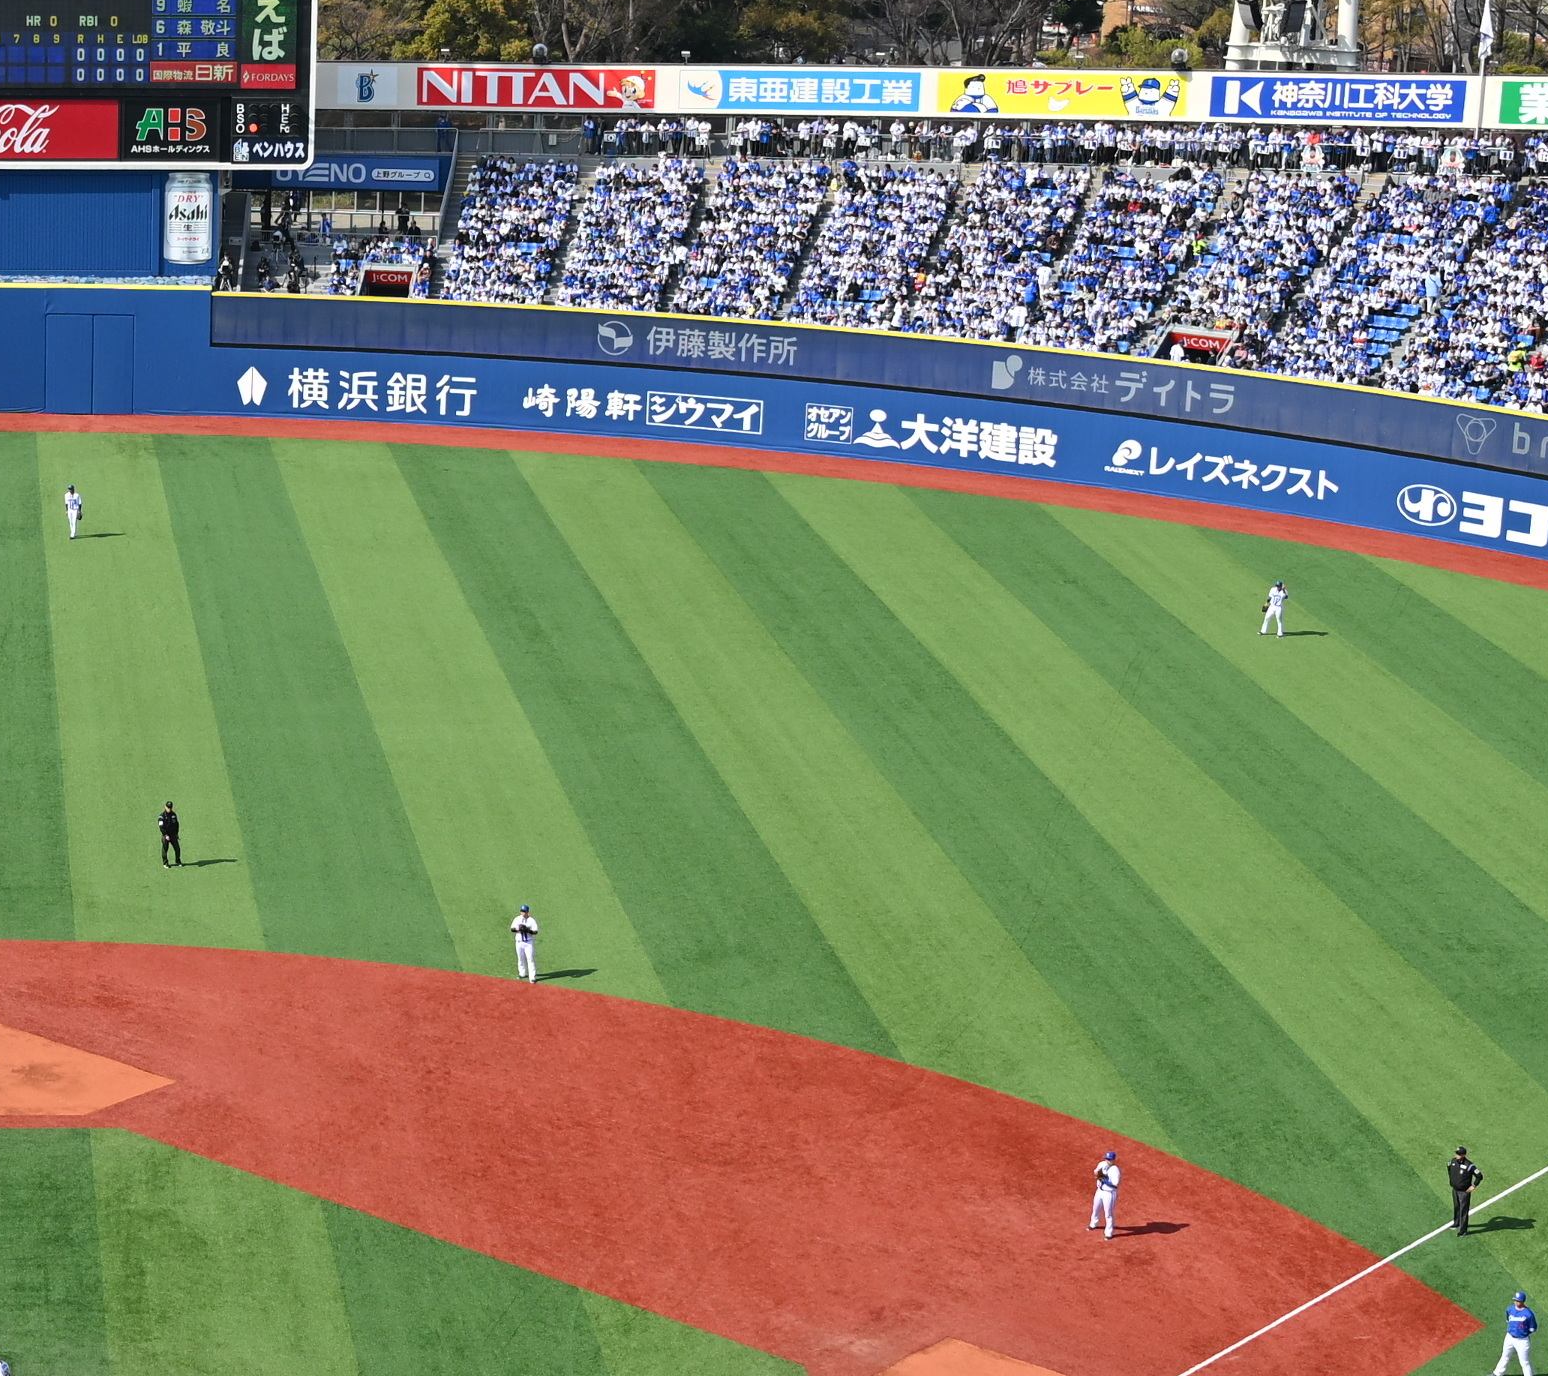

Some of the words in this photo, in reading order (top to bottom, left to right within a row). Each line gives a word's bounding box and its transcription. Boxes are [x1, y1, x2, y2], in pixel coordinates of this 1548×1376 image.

[251, 72, 294, 82] FORDAYS
[422, 69, 606, 106] NITTAN
[1006, 79, 1114, 97] 鳩サブレー
[728, 76, 912, 105] 東亜建設工業
[1271, 79, 1454, 110] 神奈川工科大学
[130, 143, 210, 154] AHSホールディングス
[374, 169, 422, 180] 上野グループ
[168, 204, 209, 221] Asahi
[371, 273, 409, 283] J:COM
[646, 324, 799, 366] 伊藤製作所
[1181, 336, 1221, 351] J:COM
[1027, 366, 1109, 394] 株式会社
[287, 367, 478, 417] 横浜銀行
[522, 383, 644, 421] 崎陽軒
[650, 394, 760, 431] シウマイ
[807, 405, 852, 423] オセアン
[806, 423, 851, 441] グループ
[901, 413, 1058, 469] 大洋建設
[1149, 446, 1339, 501] レイズネクスト
